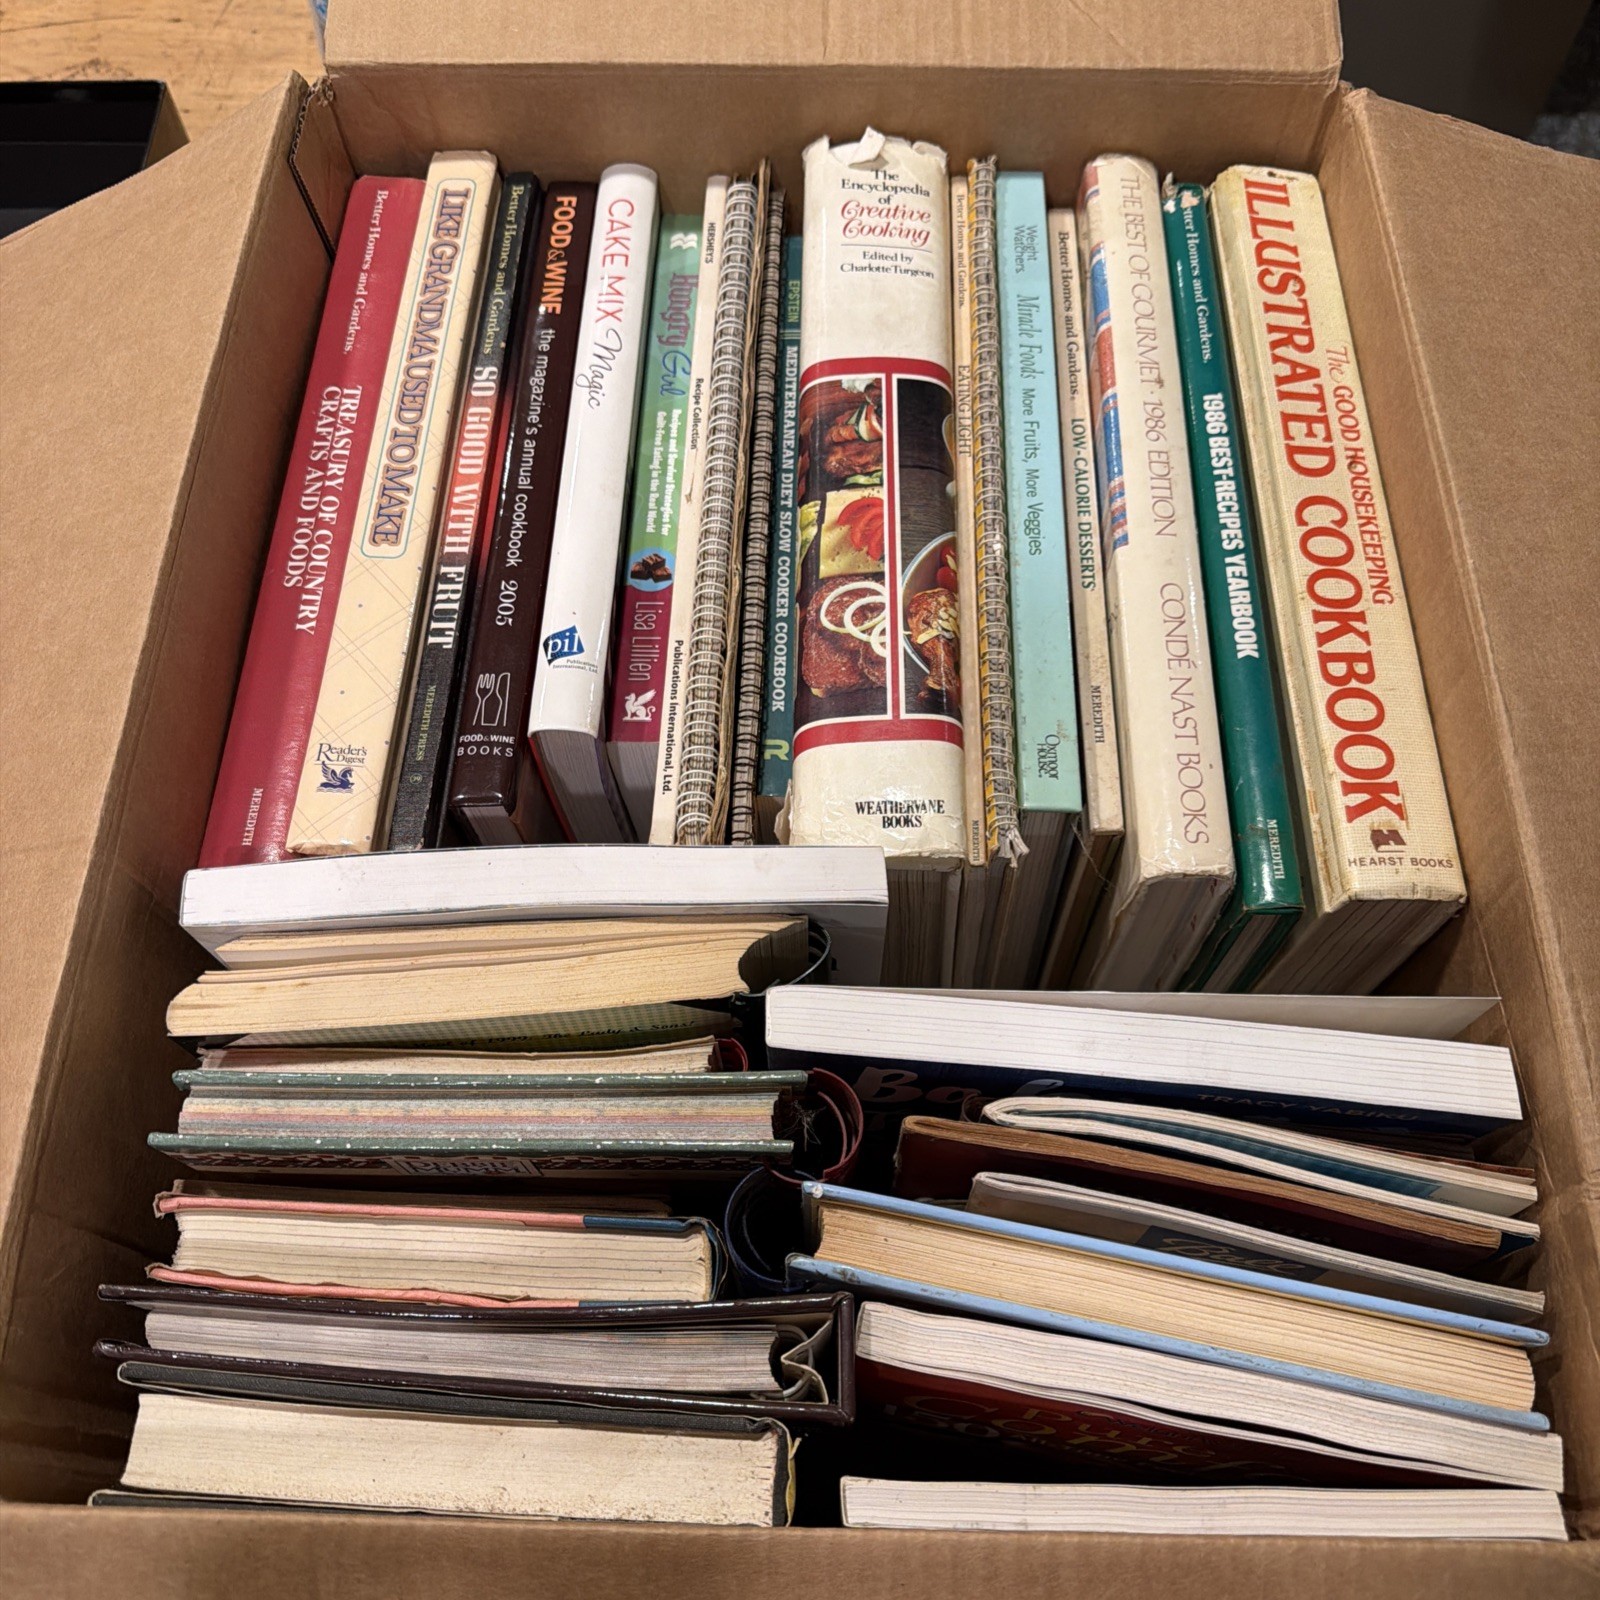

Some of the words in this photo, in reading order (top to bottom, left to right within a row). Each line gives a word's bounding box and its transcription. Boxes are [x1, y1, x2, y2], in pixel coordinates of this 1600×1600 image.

[841, 178, 930, 198] Encyclopedia
[870, 168, 900, 182] The
[1120, 176, 1142, 209] THE
[371, 189, 389, 222] Better
[433, 188, 469, 238] LIKE
[506, 185, 524, 220] Better
[840, 200, 931, 223] Creative
[878, 194, 895, 206] of
[956, 194, 965, 221] Better
[362, 225, 381, 270] Homes
[499, 222, 518, 269] Homes
[601, 198, 634, 268] CAKE
[705, 222, 717, 265] HERSHEY'S
[842, 218, 930, 247] Cooking
[957, 221, 966, 250] Homes
[1014, 225, 1026, 274] Watchers
[1025, 225, 1039, 262] Weight
[1058, 231, 1069, 268] Better
[1124, 212, 1147, 252] BEST
[840, 263, 892, 275] Charlotte
[891, 265, 935, 279] Turgeon
[862, 251, 898, 262] Edited
[900, 253, 914, 265] by
[958, 252, 966, 270] and
[1128, 255, 1151, 281] OF
[1186, 232, 1199, 276] Homes
[1193, 277, 1208, 302] and
[359, 272, 368, 295] and
[407, 241, 459, 361] GRANDMA
[492, 271, 507, 295] and
[594, 274, 626, 324] MIX
[788, 280, 800, 323] EPSTEIN
[1060, 268, 1073, 312] Homes
[482, 298, 505, 355] Gardens
[657, 272, 699, 349] Hungry
[1016, 293, 1040, 339] Miracle
[1064, 315, 1078, 339] and
[537, 328, 556, 352] the
[1131, 283, 1163, 387] GOURMET
[470, 366, 498, 397] SO
[575, 327, 623, 410] Magic
[658, 349, 692, 397] Girl
[1018, 342, 1045, 380] Foods
[1325, 344, 1351, 384] The
[395, 361, 434, 427] USED
[525, 354, 548, 436] magazine's
[691, 378, 705, 404] Recipe
[780, 345, 798, 469] MEDITERRANEAN
[957, 365, 972, 412] EATING
[1021, 387, 1036, 416] More
[310, 386, 342, 462] CRAFTS
[669, 408, 682, 438] Recipes
[690, 404, 703, 450] Collection
[957, 412, 973, 458] LIGHT
[1143, 398, 1167, 443] 1986
[1202, 392, 1229, 435] 1986
[1333, 385, 1361, 442] GOOD
[325, 385, 362, 490] TREASURY
[386, 427, 421, 463] TO
[458, 406, 492, 475] GOOD
[668, 438, 679, 453] and
[1022, 420, 1041, 464] Fruits,
[517, 439, 537, 490] annual
[650, 478, 660, 492] the
[1025, 468, 1040, 498] More
[1071, 418, 1092, 517] LOW-CALORIE
[299, 467, 325, 511] AND
[318, 496, 339, 525] OF
[368, 464, 418, 546] MAKE
[780, 472, 794, 508] DIET
[1147, 450, 1178, 537] EDITION
[1208, 435, 1245, 551] BEST-RECIPES
[1243, 178, 1337, 479] ILLUSTRATED
[1295, 495, 1406, 823] COOKBOOK
[444, 482, 481, 555] WITH
[505, 494, 528, 568] cookbook
[660, 523, 671, 536] for
[778, 511, 793, 553] SLOW
[1024, 502, 1047, 556] Veggies
[1344, 446, 1395, 606] HOUSEKEEPING
[282, 517, 316, 588] FOODS
[1077, 521, 1096, 590] DESSERTS
[294, 529, 335, 635] COUNTRY
[495, 579, 519, 627] 2005
[775, 556, 791, 618] COOKER
[427, 564, 466, 649] FRUIT
[633, 601, 665, 631] Lisa
[1159, 582, 1197, 671] CONDÉ
[1224, 552, 1260, 660] YEARBOOK
[547, 631, 579, 660] pil
[628, 636, 662, 683] Lillien
[771, 622, 789, 713] COOKBOOK
[670, 639, 684, 700] Publications
[420, 685, 437, 730] MEREDITH
[1091, 685, 1105, 744] MEREDITH
[1169, 677, 1199, 745] NAST
[316, 743, 368, 762] Reader's
[337, 754, 365, 764] Digest
[416, 733, 428, 761] PRESS
[457, 745, 514, 758] BOOKS
[663, 702, 680, 772] International,
[1045, 734, 1061, 780] Oxmoor
[662, 773, 673, 796] Ltd.
[1176, 752, 1210, 845] BOOKS
[241, 787, 264, 846] MEREDITH
[881, 814, 922, 829] BOOKS
[971, 819, 980, 863] MEREDITH
[1266, 819, 1286, 880] MEREDITH
[1347, 856, 1404, 868] HEARST
[1410, 857, 1454, 869] BOOKS
[1198, 1094, 1298, 1109] TRACY
